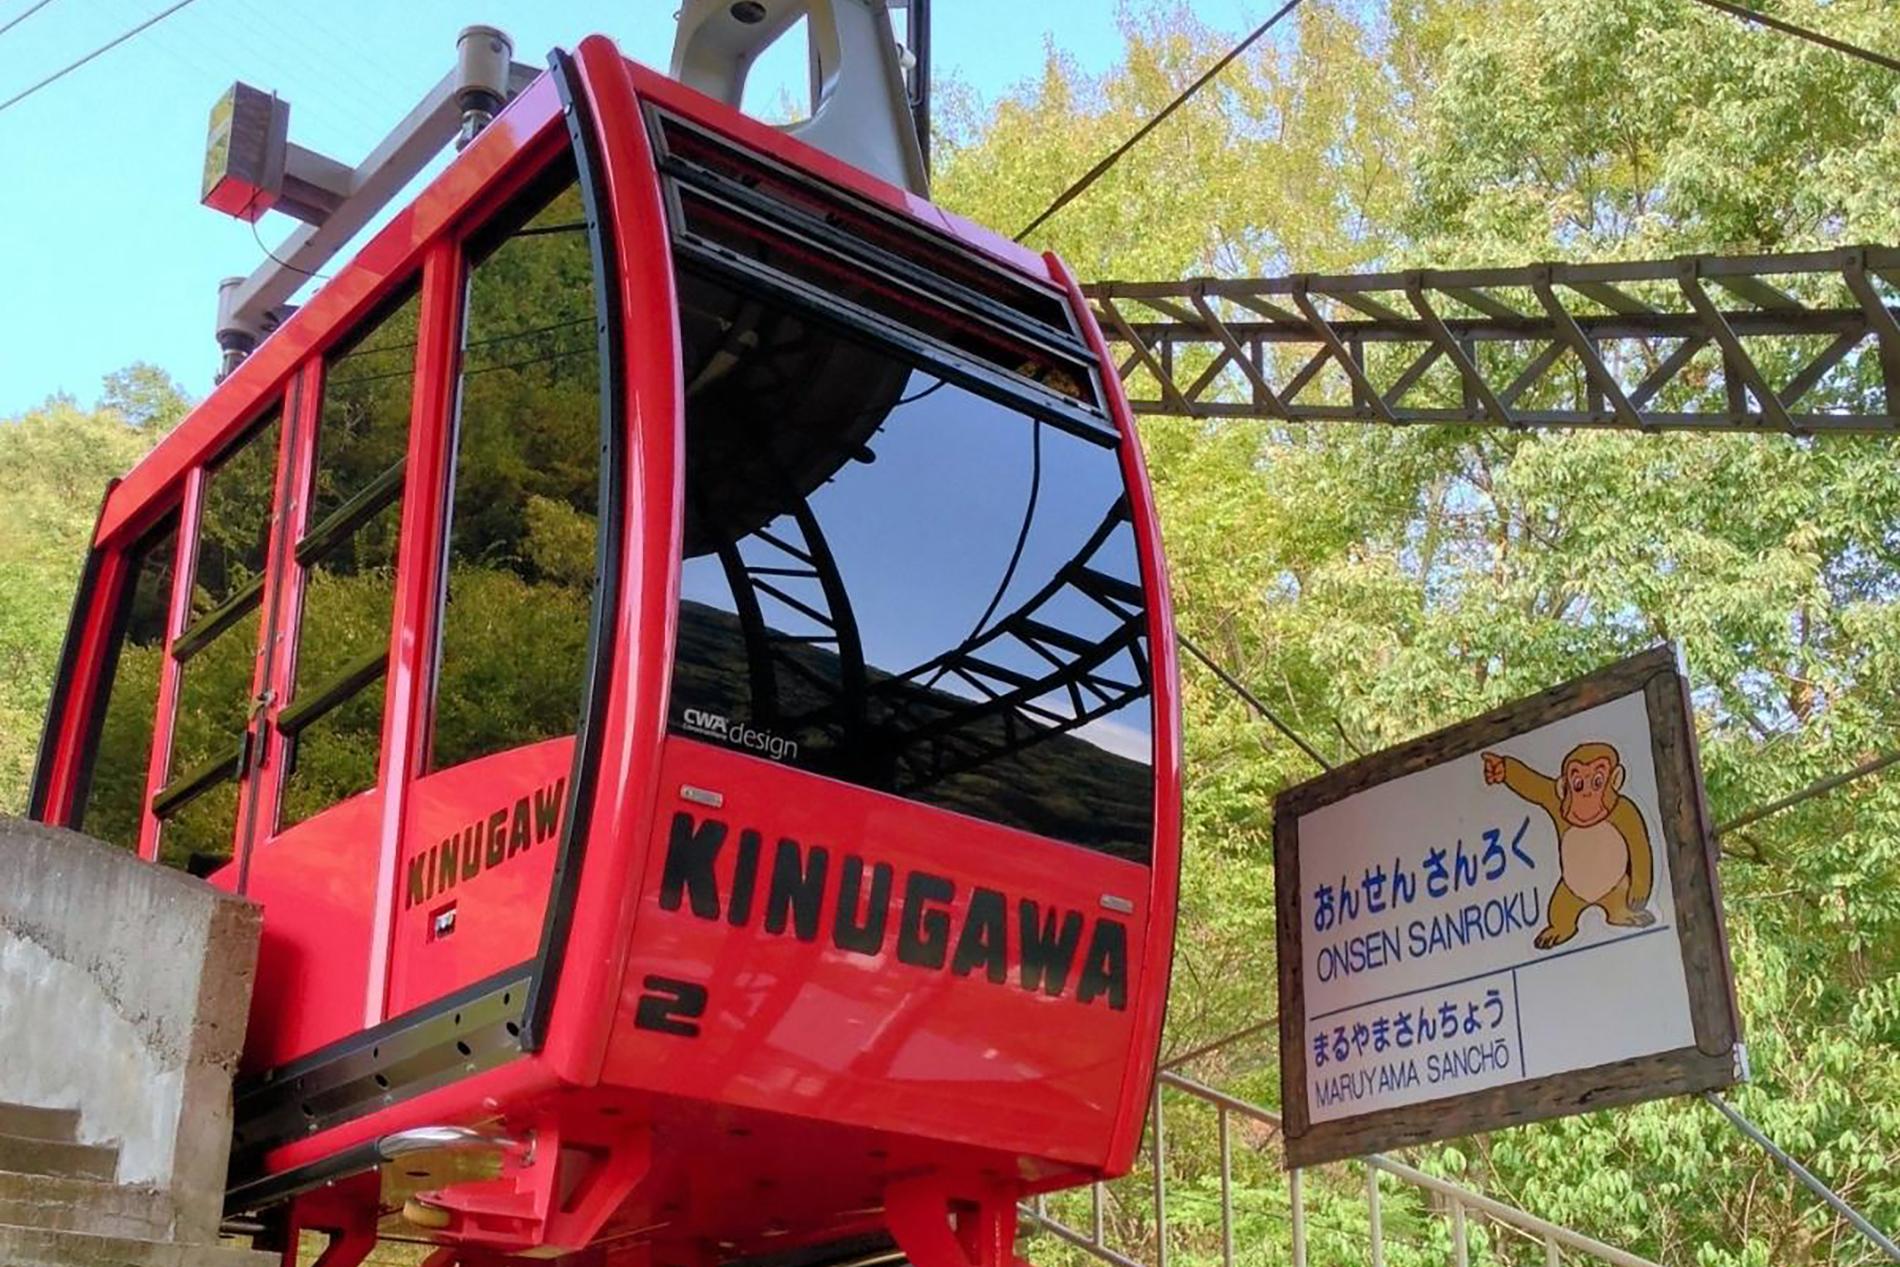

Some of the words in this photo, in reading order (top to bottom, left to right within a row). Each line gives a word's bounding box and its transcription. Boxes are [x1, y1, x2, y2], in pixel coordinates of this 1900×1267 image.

[683, 708, 728, 734] CWA
[729, 722, 798, 759] design
[405, 776, 566, 911] KINUGAW
[658, 812, 1130, 1011] KINUGAWA
[1316, 926, 1402, 982] ONSEN
[1408, 887, 1540, 958] SANROKU
[634, 975, 708, 1037] 2
[1313, 989, 1504, 1068] まるやまさんちょう
[1315, 1061, 1420, 1109] MARUYAMA
